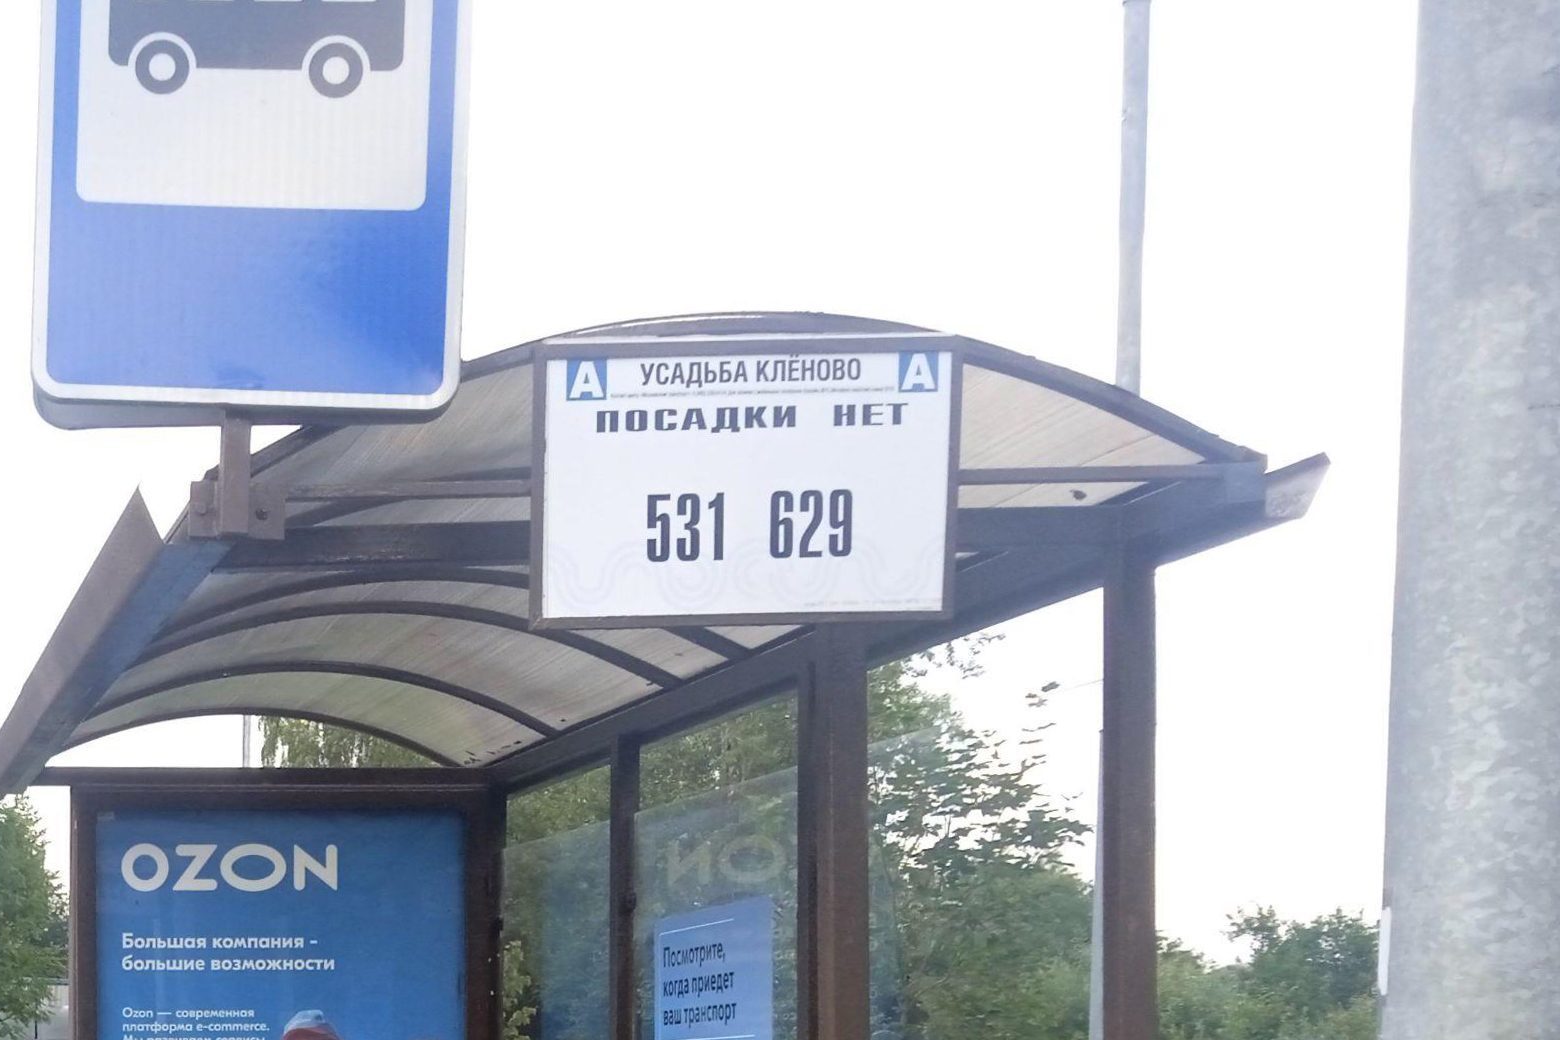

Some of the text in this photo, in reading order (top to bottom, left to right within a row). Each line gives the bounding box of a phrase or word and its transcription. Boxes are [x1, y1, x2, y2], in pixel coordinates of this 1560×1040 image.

[640, 354, 861, 388] УСАДЬБА КЛЁНОВО
[596, 402, 909, 434] ПОСАДКИ НЕТ
[646, 488, 854, 562] 531 629
[121, 843, 338, 892] OZON
[122, 932, 207, 949] Большая
[212, 936, 304, 949] компания
[122, 954, 335, 971] большие возможности
[663, 942, 726, 968] Посмотрите,
[663, 971, 734, 998] когда приедет
[122, 1007, 153, 1018] Ozon
[176, 1008, 255, 1020] современная
[663, 1003, 737, 1029] ваш транспорт
[122, 1021, 270, 1034] платформа e-commerce.
